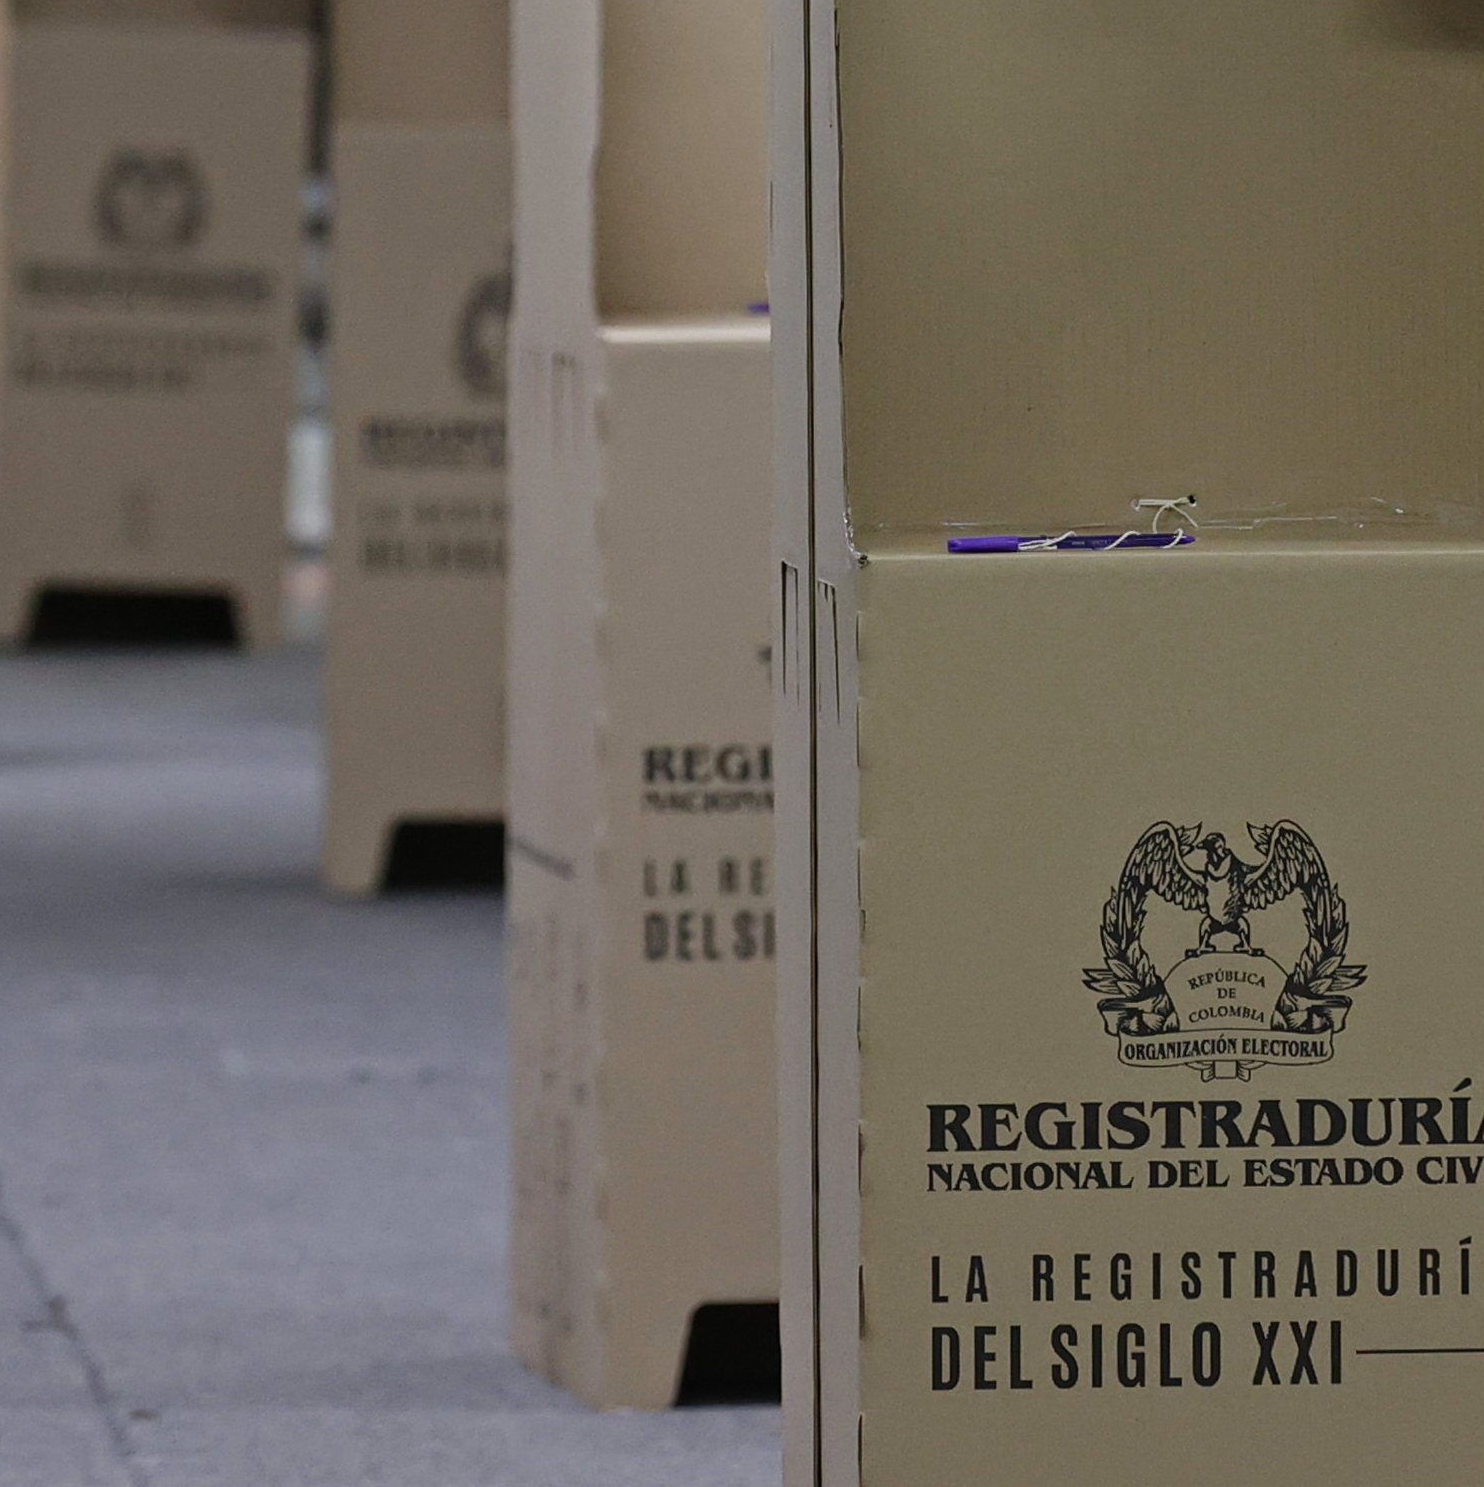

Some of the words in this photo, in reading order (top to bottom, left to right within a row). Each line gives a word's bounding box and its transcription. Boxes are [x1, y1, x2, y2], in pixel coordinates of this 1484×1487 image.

[1187, 967, 1266, 992] REPÚBLICA
[1217, 987, 1236, 999] DE
[1188, 1005, 1265, 1024] COLOMBIA
[1124, 1034, 1237, 1061] ORGANIZACIÓN
[1241, 1037, 1328, 1058] ELECTORAL
[926, 1161, 1133, 1192] NACIONAL
[1147, 1159, 1229, 1189] DEL
[1243, 1156, 1404, 1187] ESTADO
[931, 1255, 989, 1304] LA
[931, 1325, 1033, 1391] DEL
[1050, 1321, 1221, 1390] SIGLO
[1252, 1320, 1342, 1386] XXI
